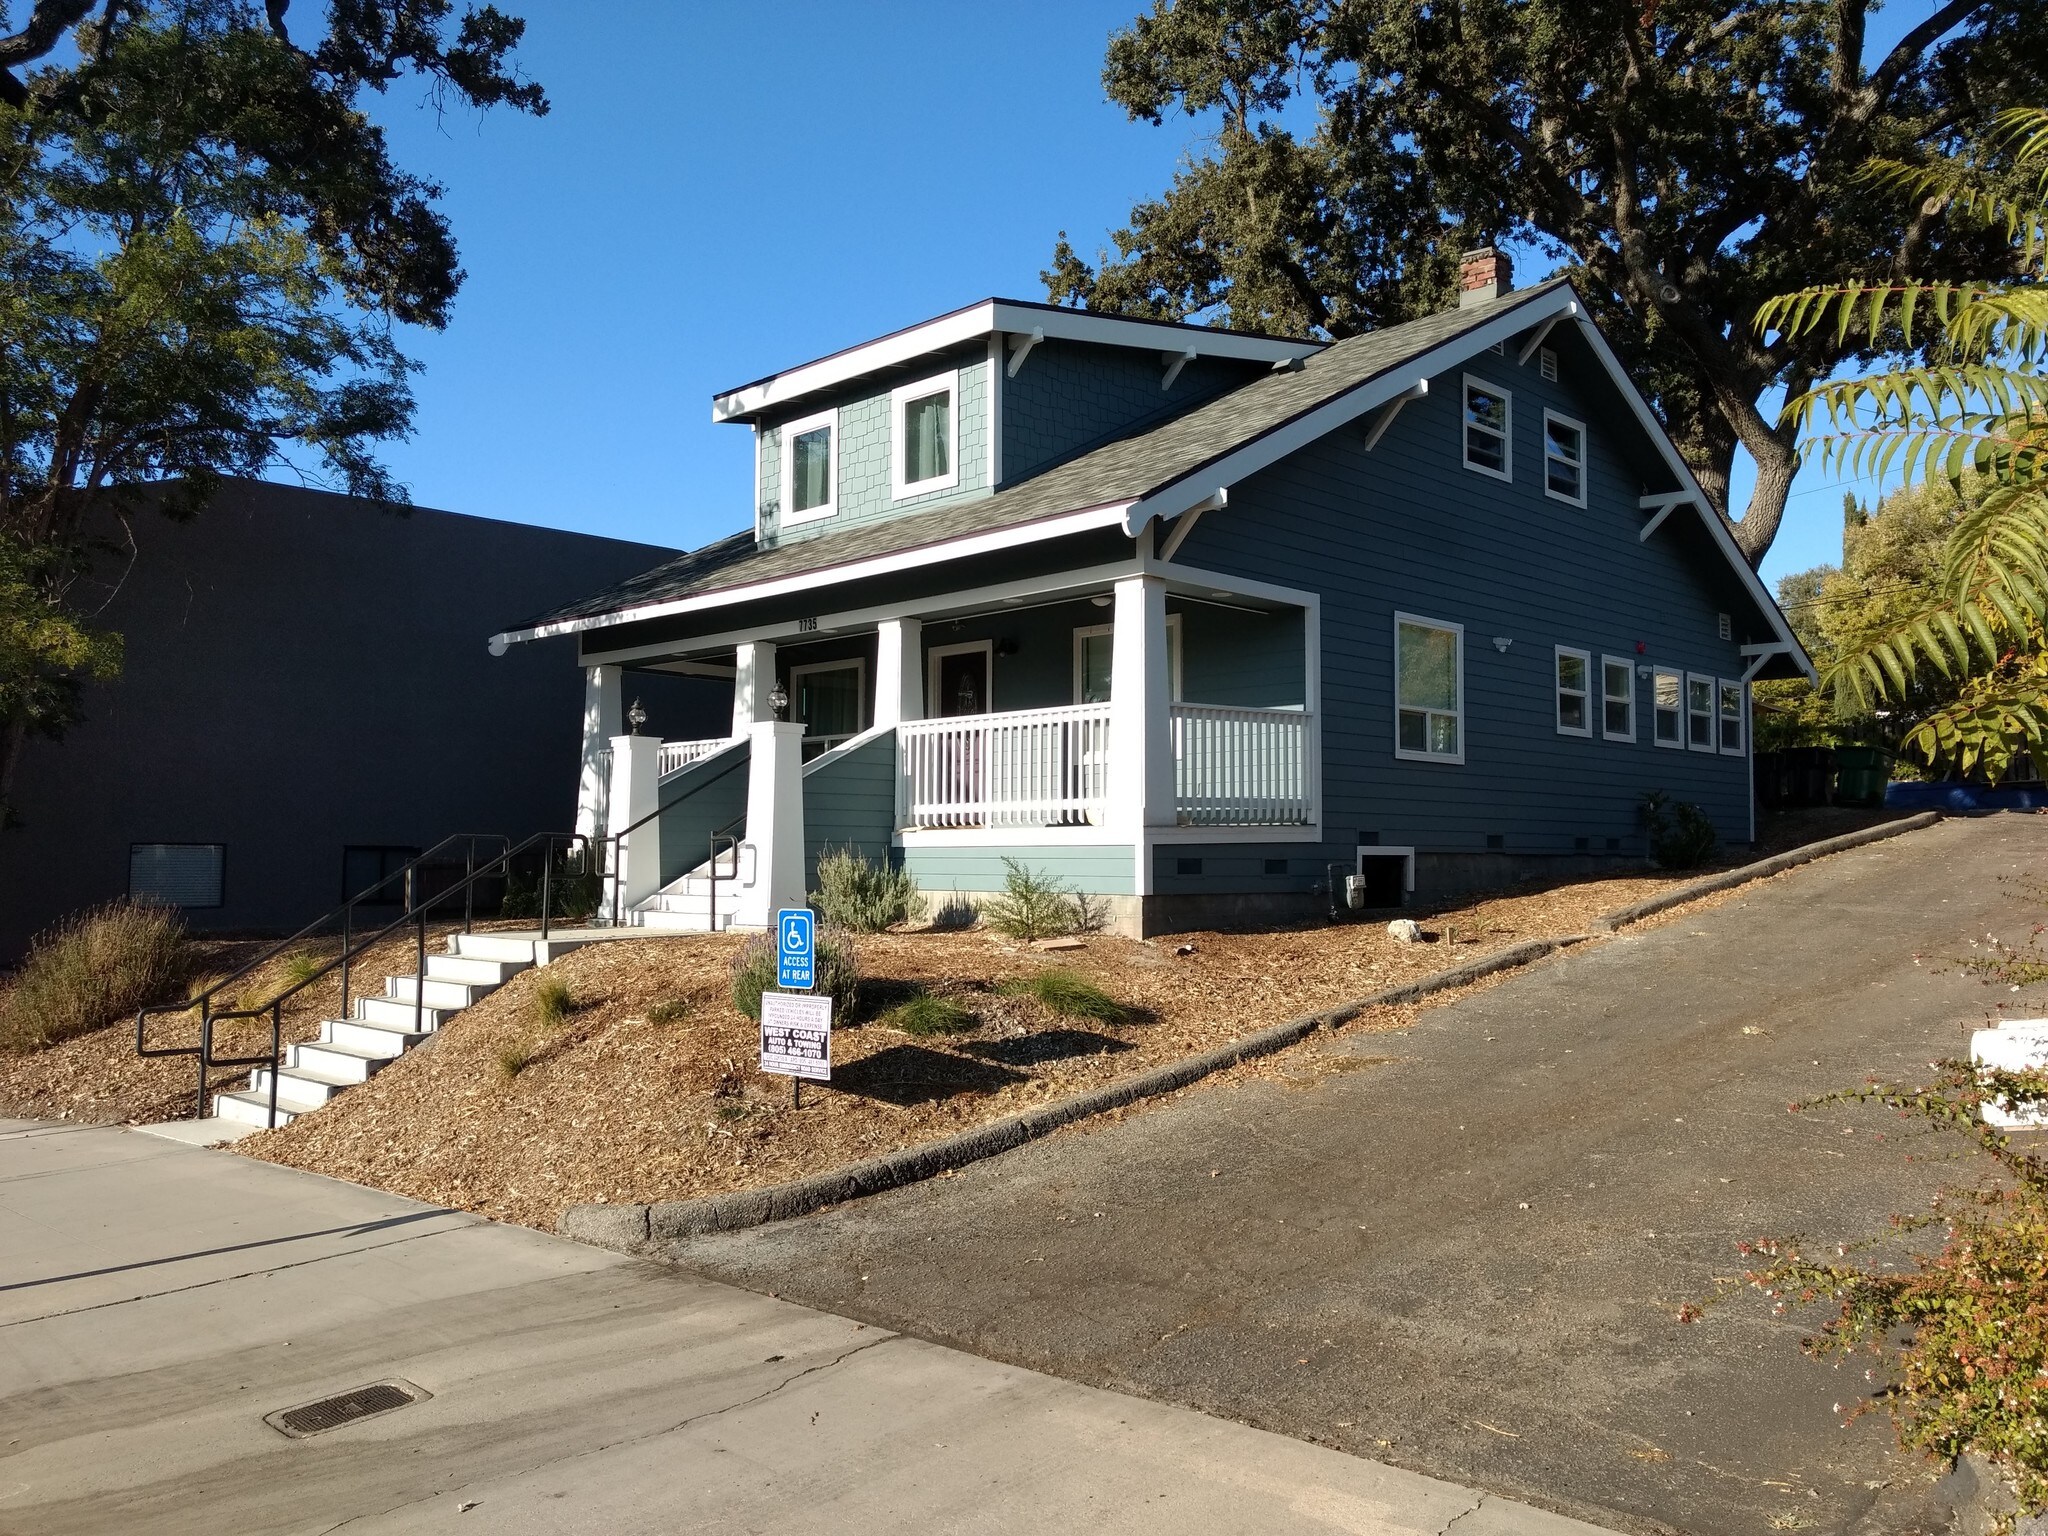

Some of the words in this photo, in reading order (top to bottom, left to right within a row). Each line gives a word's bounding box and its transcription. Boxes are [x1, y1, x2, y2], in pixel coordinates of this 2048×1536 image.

[783, 956, 808, 968] ACCESS
[782, 969, 790, 980] AT
[792, 970, 810, 980] REAR
[764, 1026, 790, 1037] WEST
[793, 1030, 826, 1042] COAST
[768, 1037, 786, 1046] AUTO
[794, 1040, 821, 1050] TOWING
[768, 1045, 786, 1054] (805)
